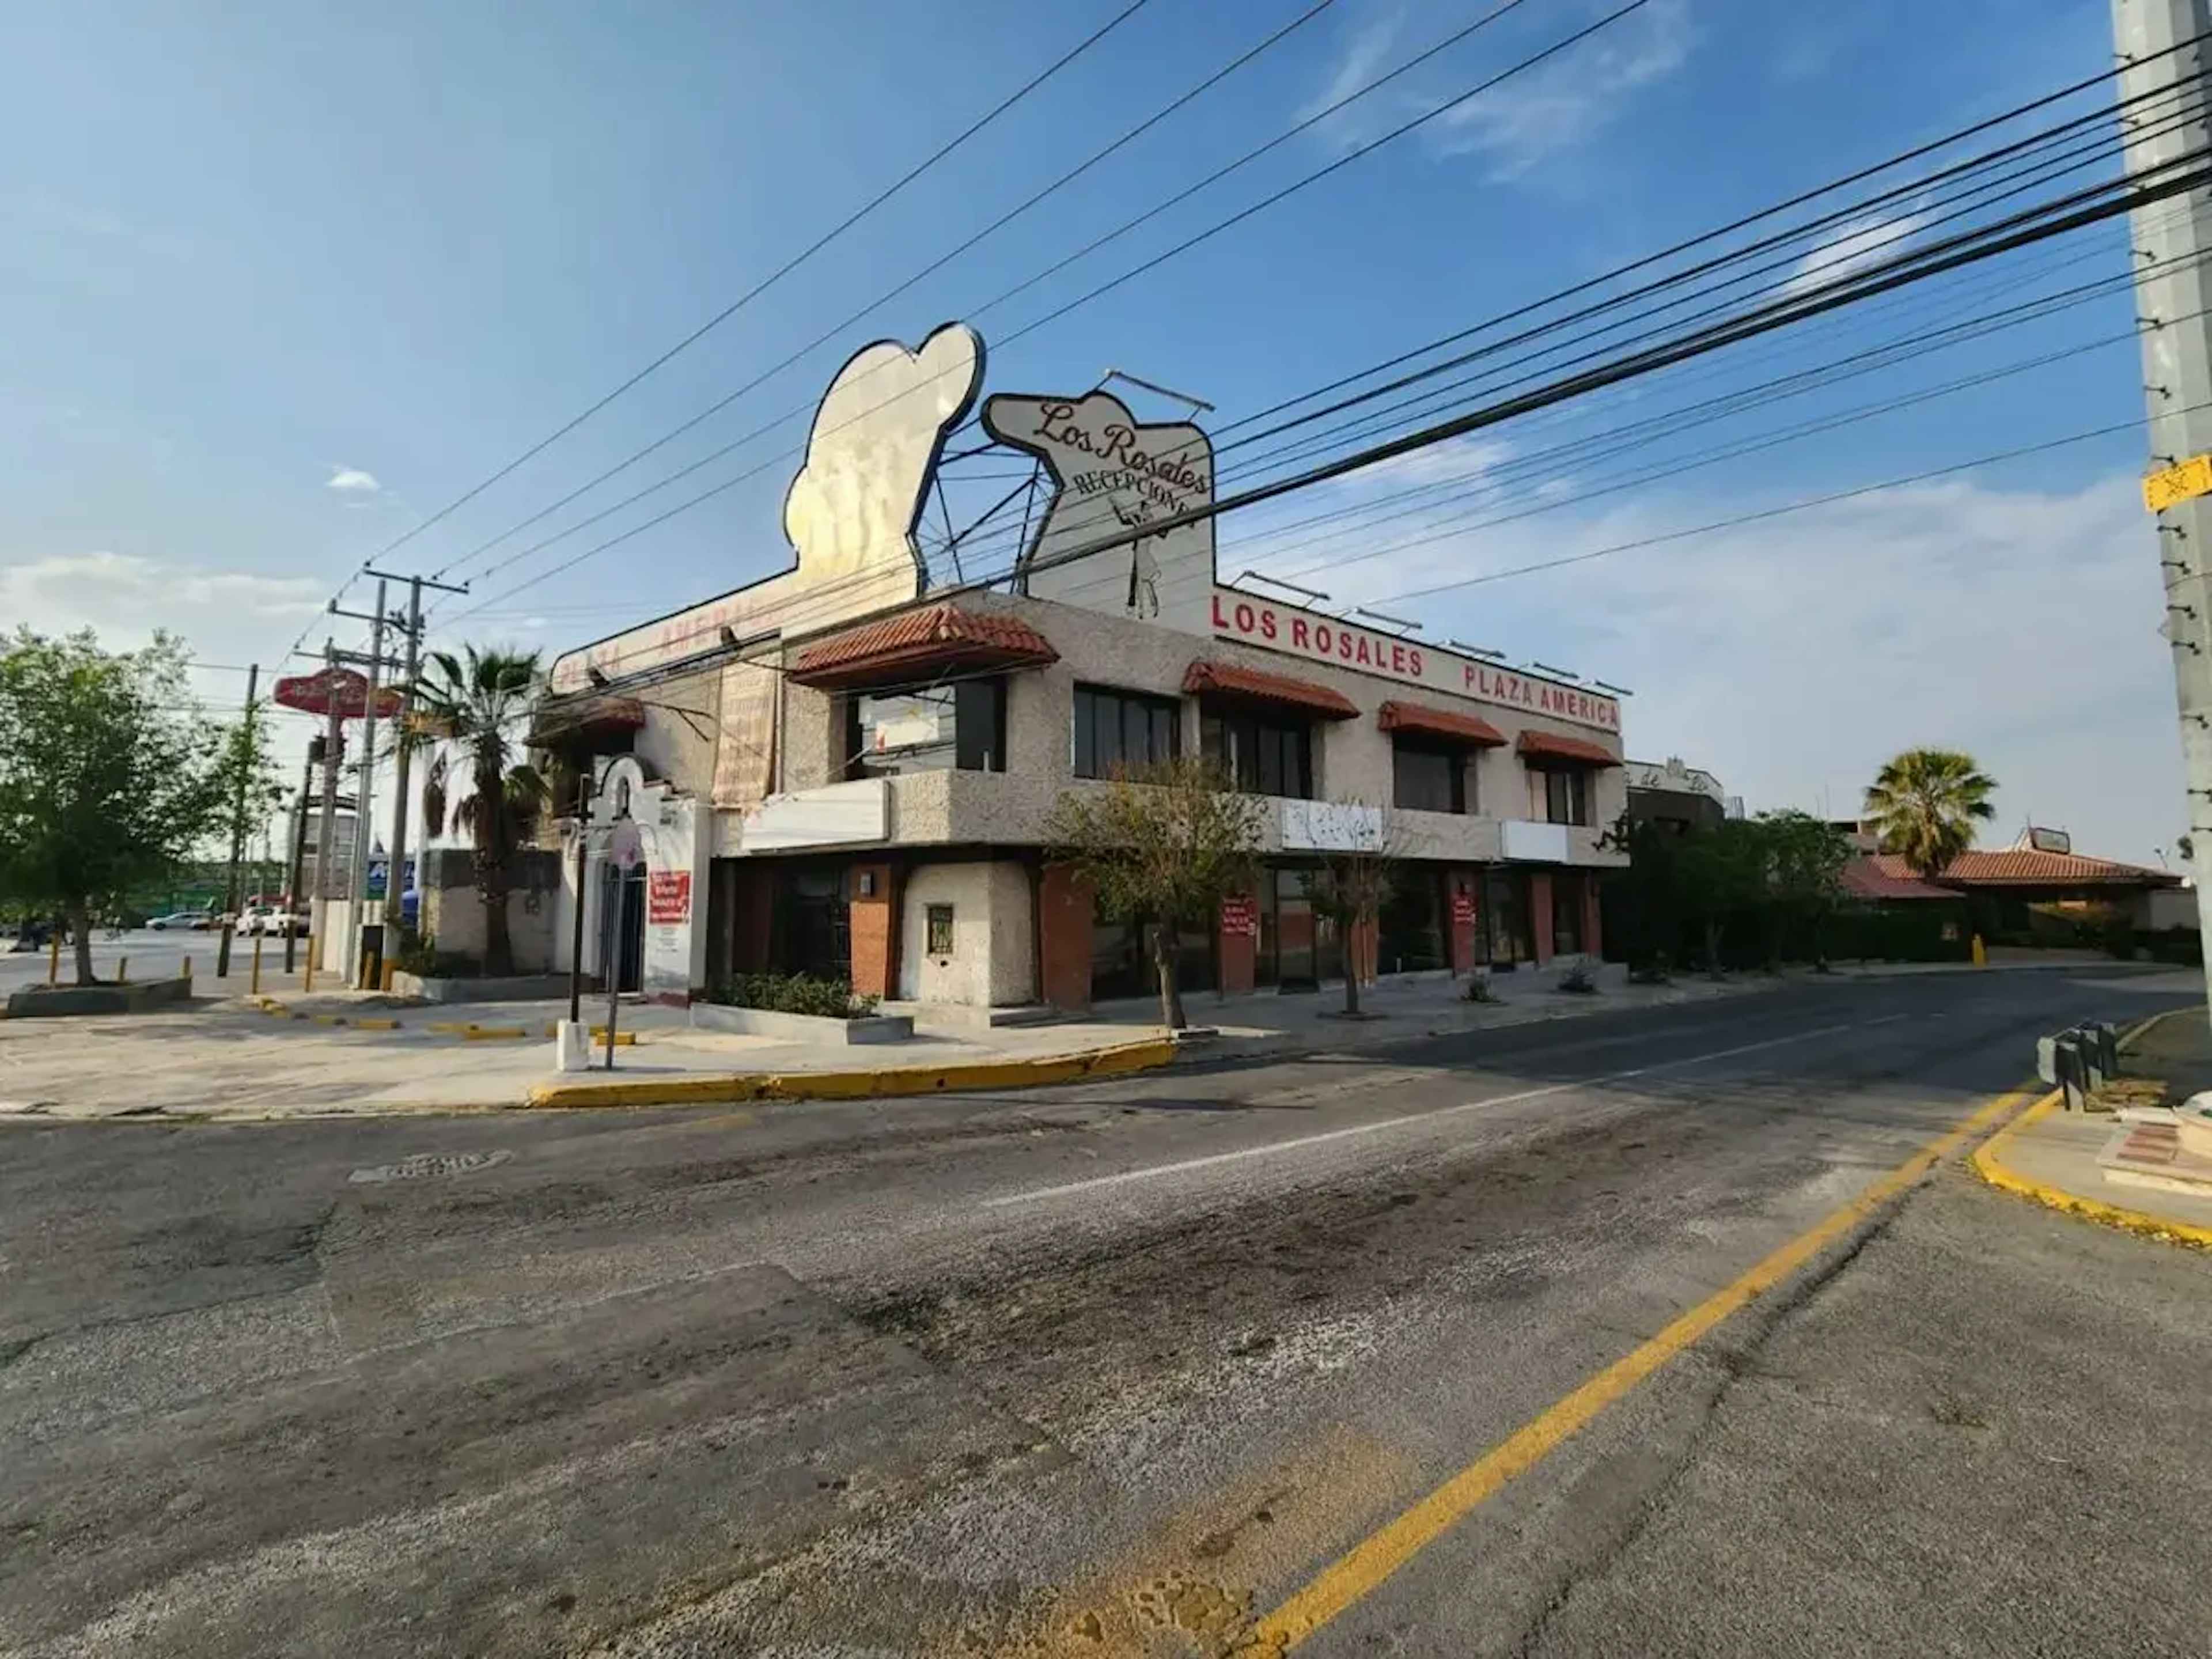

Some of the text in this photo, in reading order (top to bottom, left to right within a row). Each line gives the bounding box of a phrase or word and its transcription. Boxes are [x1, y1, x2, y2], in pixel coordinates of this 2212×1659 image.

[1032, 403, 1207, 494] Los Rosales
[1073, 470, 1195, 528] RECEPCION
[1213, 595, 1423, 676] LOS ROSALES
[1464, 665, 1619, 726] PLAZA AMERICA
